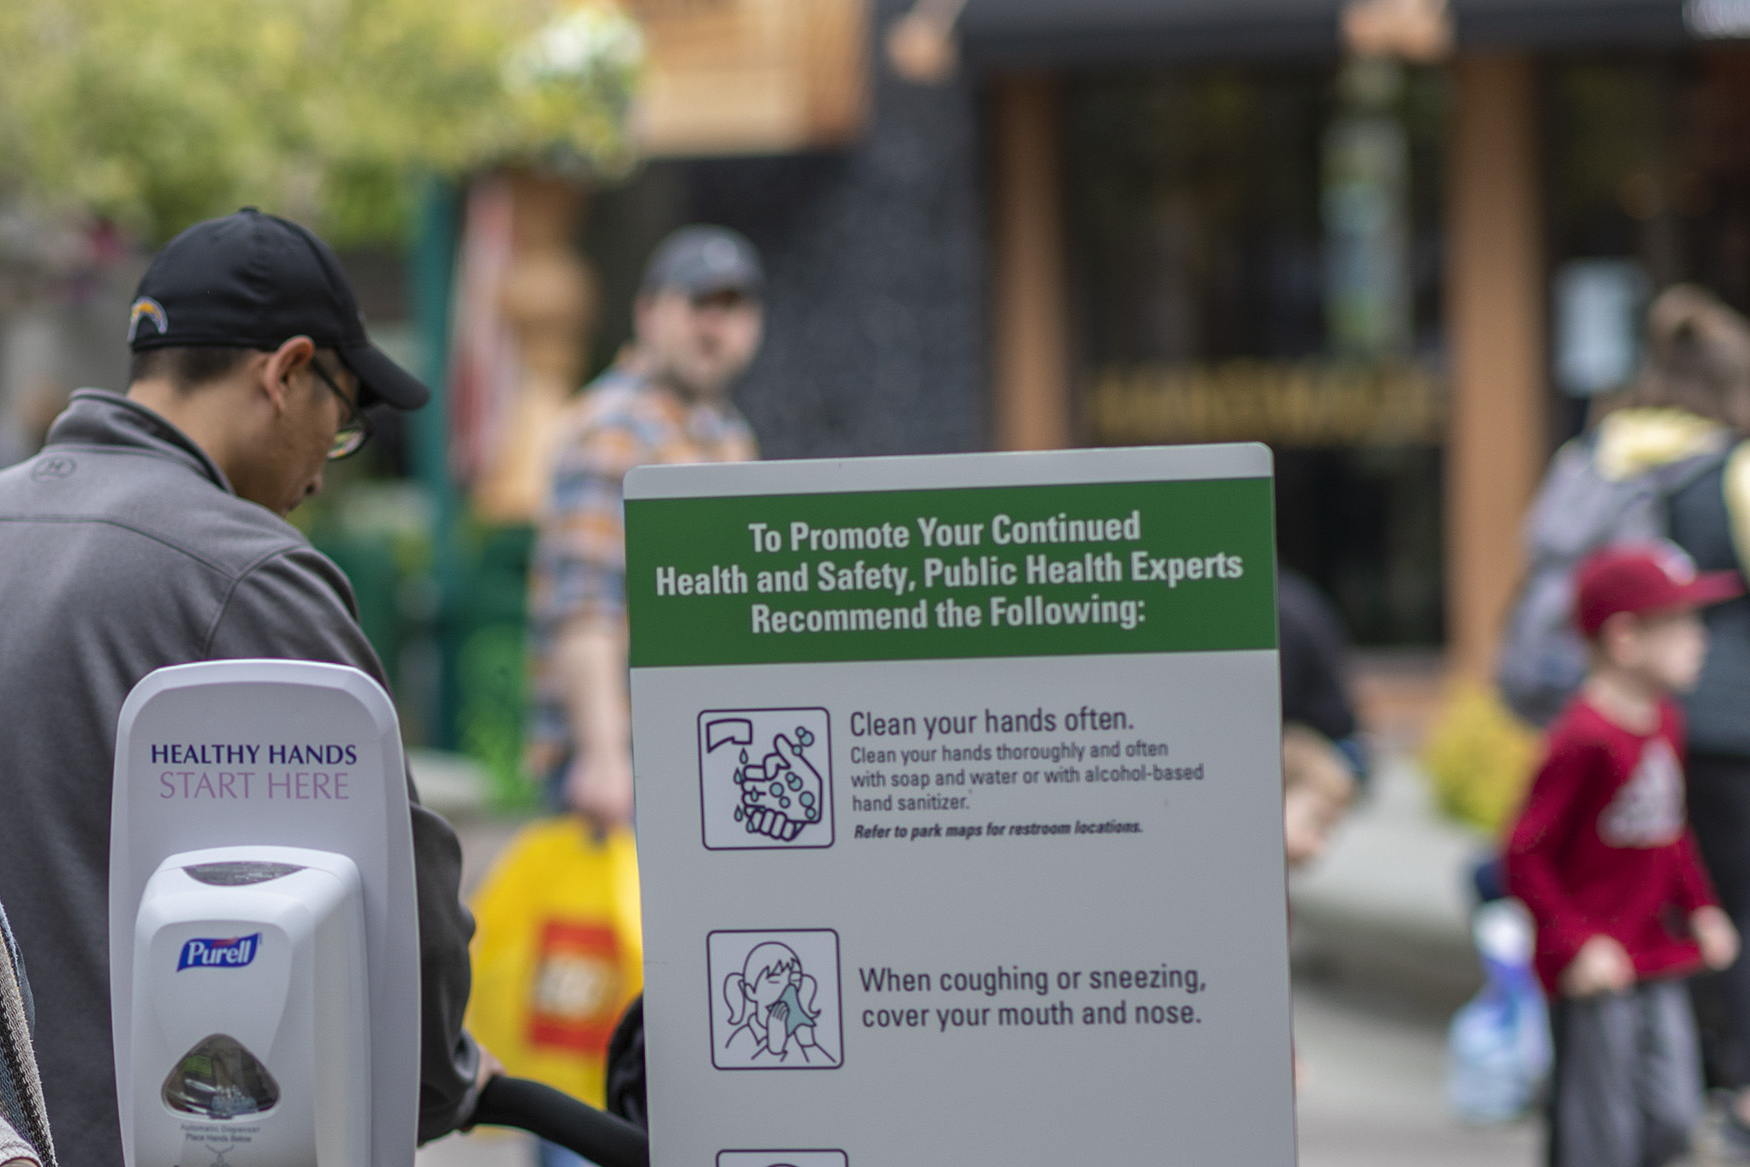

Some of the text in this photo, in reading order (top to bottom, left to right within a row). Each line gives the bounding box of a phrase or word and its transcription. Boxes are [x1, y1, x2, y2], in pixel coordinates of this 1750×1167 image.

[748, 510, 1141, 552] To Promote Your Continued
[656, 550, 1244, 596] Health and Safety, Public Health Experts
[751, 594, 1145, 634] Recommend the Following:
[850, 706, 1134, 740] Clean your hands often.
[151, 744, 357, 765] HEALTHY HANDS
[850, 739, 1168, 767] Clean your hands thoroughly and often
[160, 771, 348, 799] START HERE
[850, 763, 1204, 789] with soap and water or with alcohol-based
[852, 793, 970, 812] hand sanitizer.
[854, 819, 1143, 841] Refer to park maps for restroom locations.
[187, 940, 251, 965] Purell
[859, 963, 1206, 996] When coughing or sneezing,
[862, 999, 1201, 1032] cover your mouth and nose.
